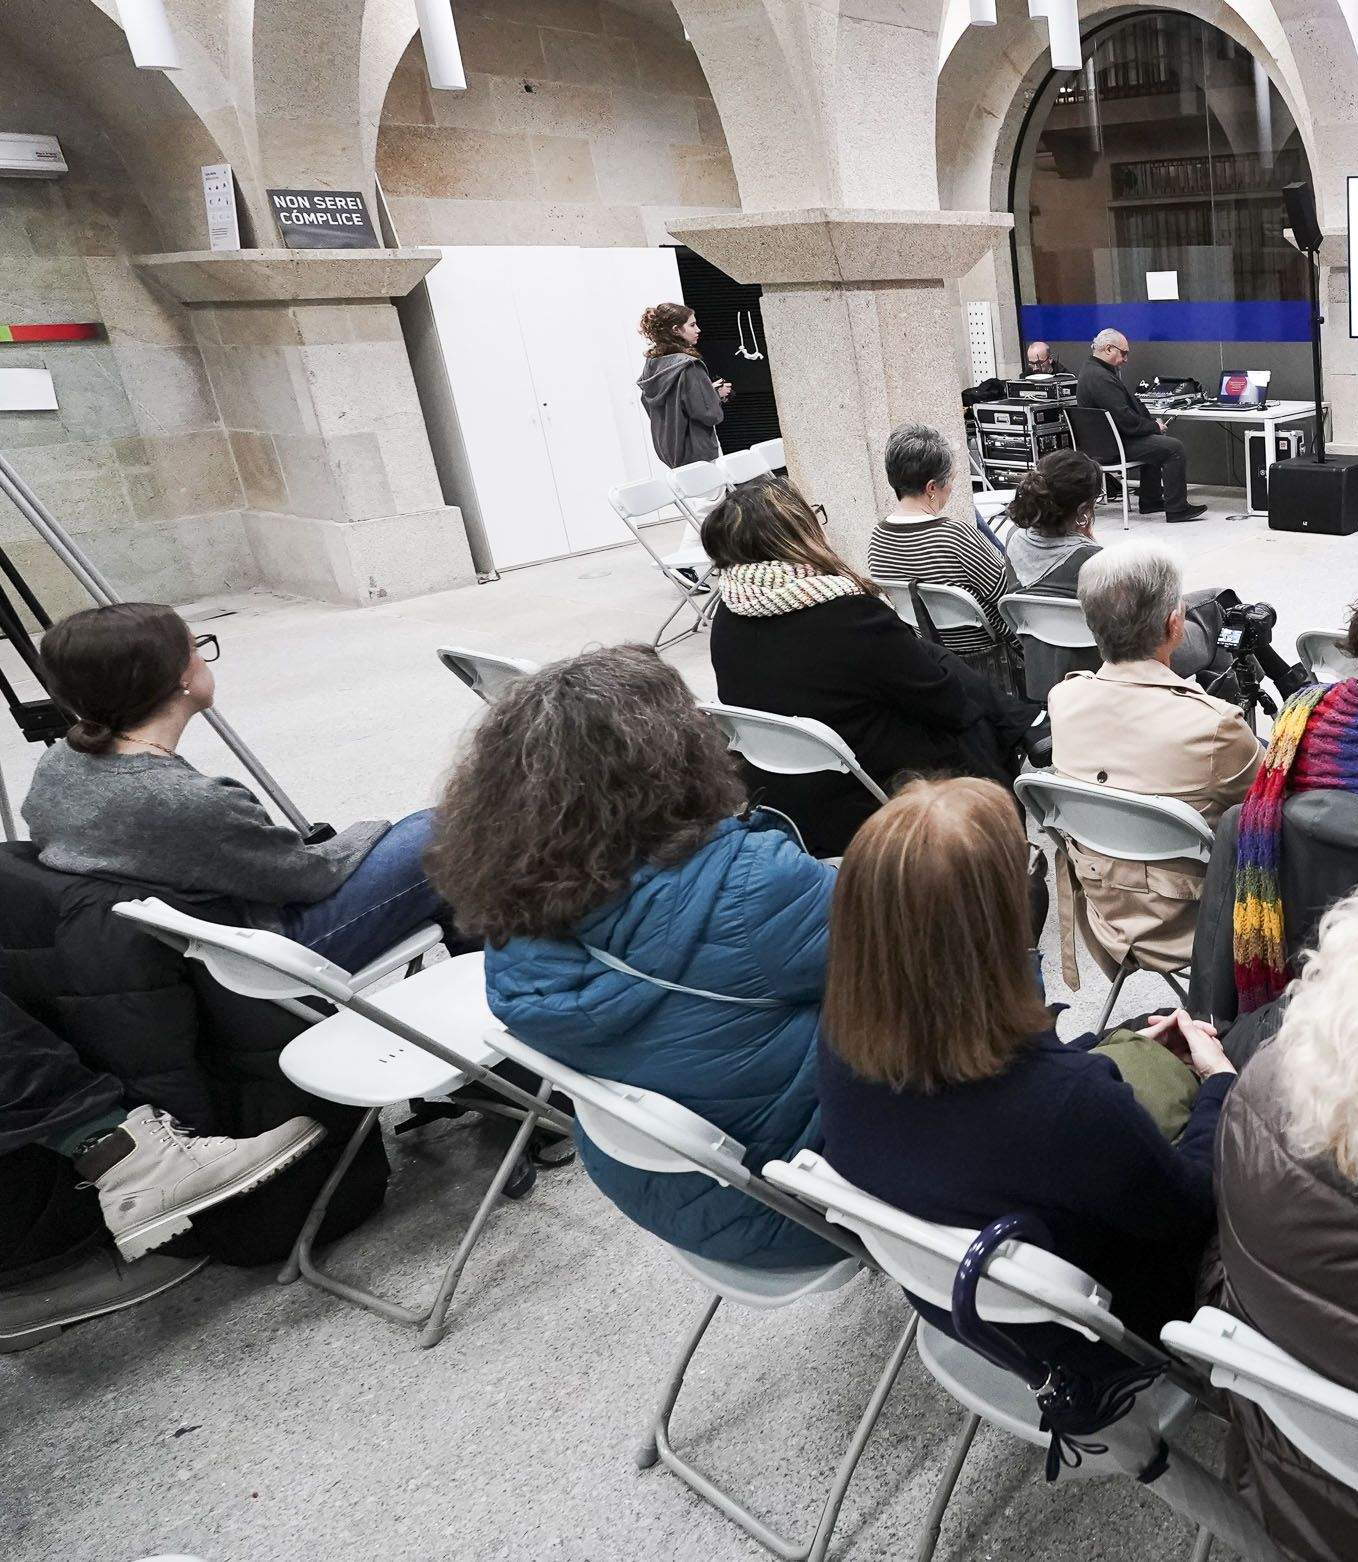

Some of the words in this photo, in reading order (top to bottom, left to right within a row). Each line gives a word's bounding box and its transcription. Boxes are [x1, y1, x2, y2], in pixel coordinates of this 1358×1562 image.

[273, 195, 311, 209] NON
[313, 196, 362, 210] SEREI
[280, 209, 363, 226] CÓMPLICE
